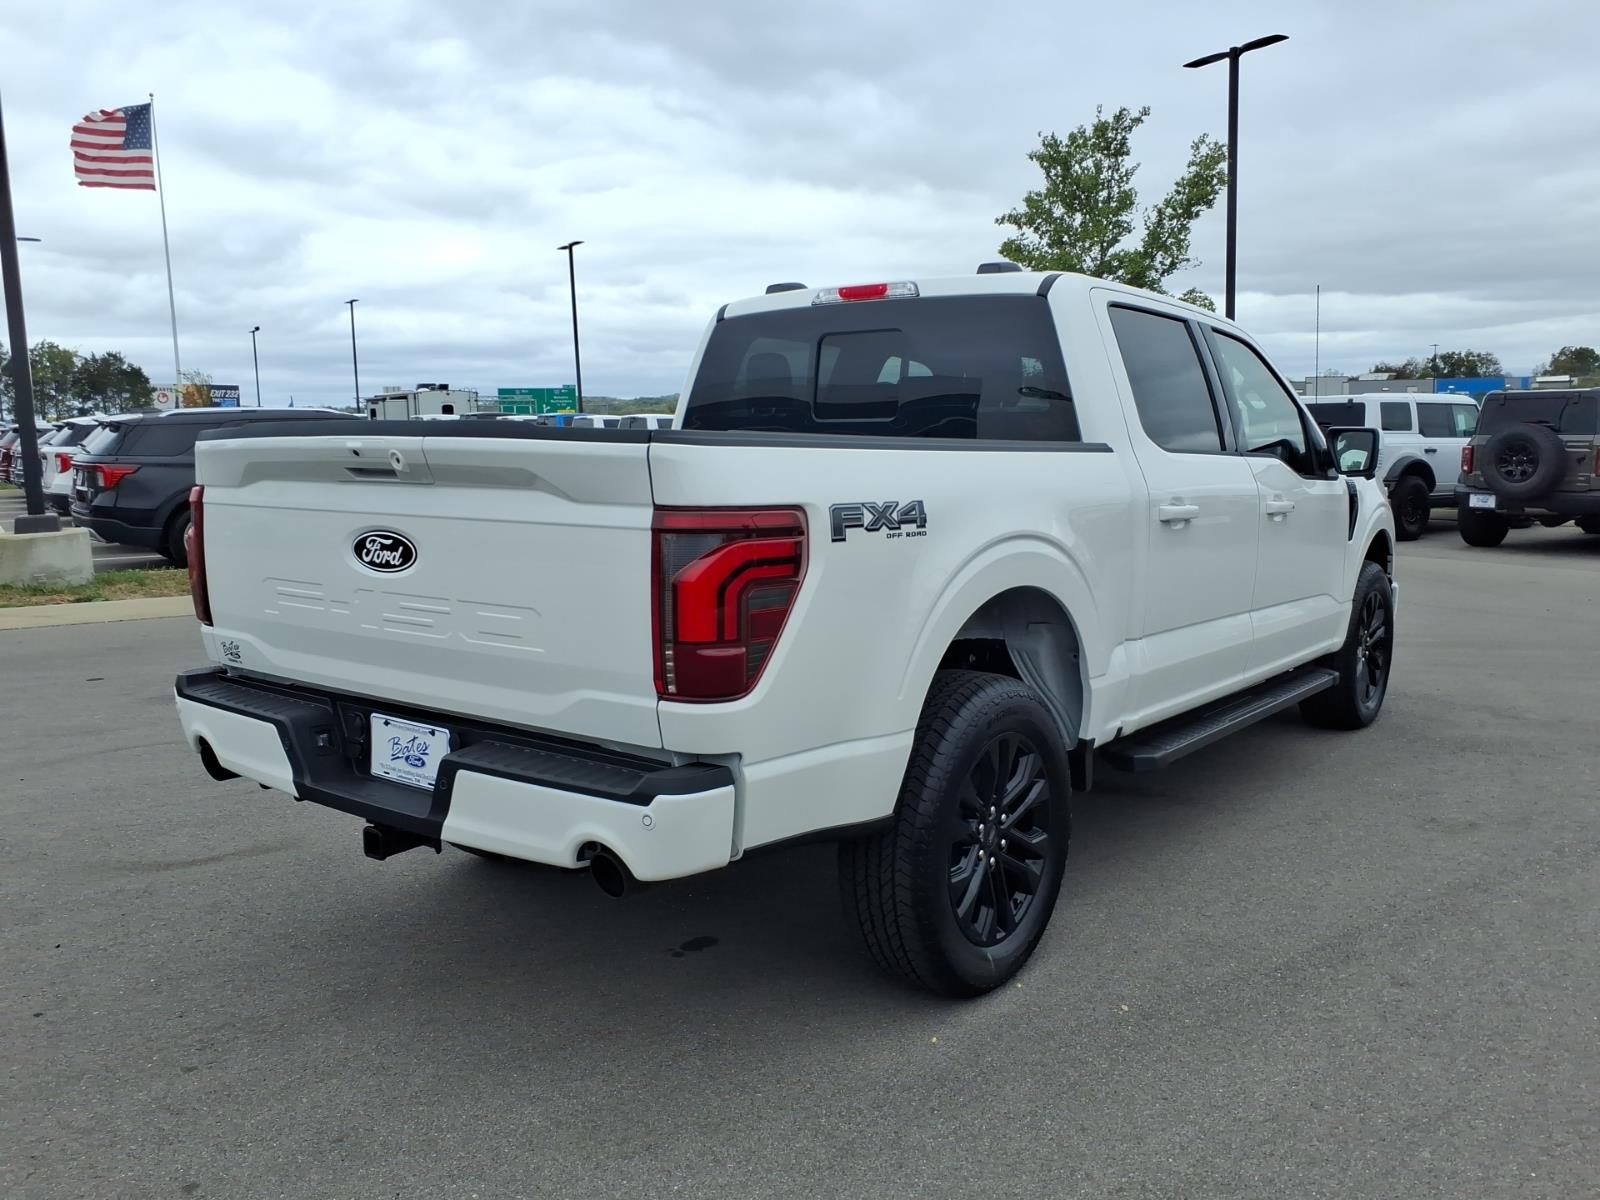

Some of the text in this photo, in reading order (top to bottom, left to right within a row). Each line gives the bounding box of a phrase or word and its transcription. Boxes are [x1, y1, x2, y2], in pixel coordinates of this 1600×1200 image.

[210, 389, 239, 398] EXIT 232
[829, 500, 927, 542] FX4
[905, 530, 927, 538] ROAD
[361, 536, 404, 566] Ford
[388, 735, 430, 757] Bates
